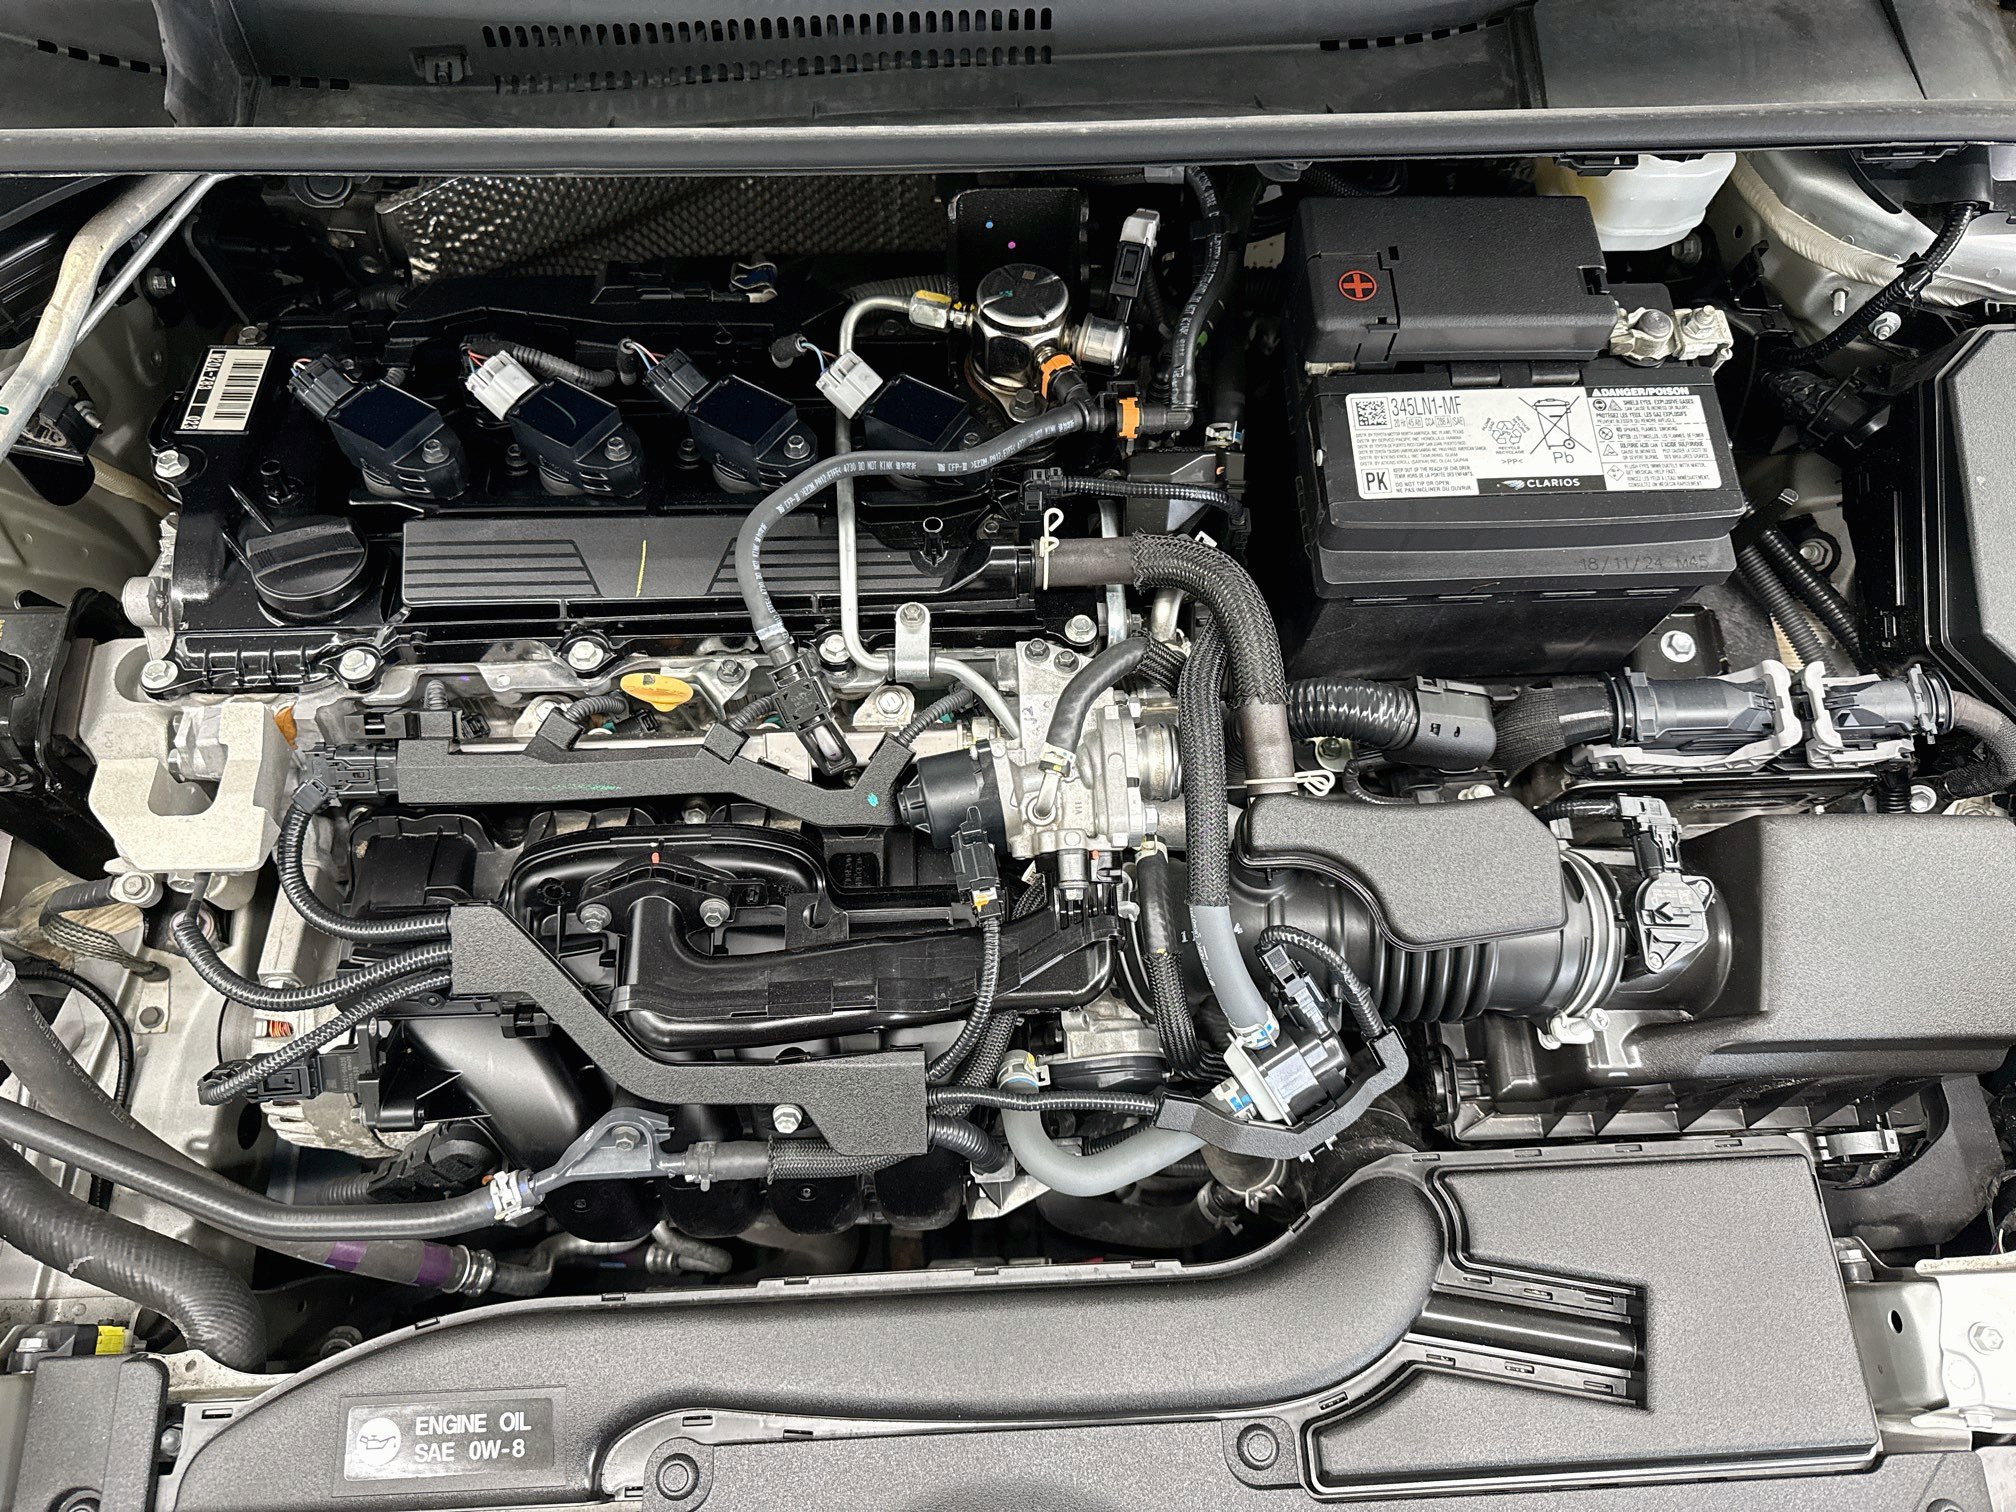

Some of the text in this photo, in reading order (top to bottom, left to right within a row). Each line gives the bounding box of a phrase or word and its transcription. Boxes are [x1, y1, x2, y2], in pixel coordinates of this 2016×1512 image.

[1391, 396, 1462, 417] 345LN1-MF
[880, 460, 893, 470] KINK
[1552, 452, 1574, 464] Pb
[1366, 472, 1388, 491] PK
[1526, 478, 1580, 488] CLARIOS
[1578, 554, 1710, 574] 18/11/24 M45
[415, 1411, 532, 1436] ENGINE OIL
[414, 1438, 526, 1463] SAE 0W-8
